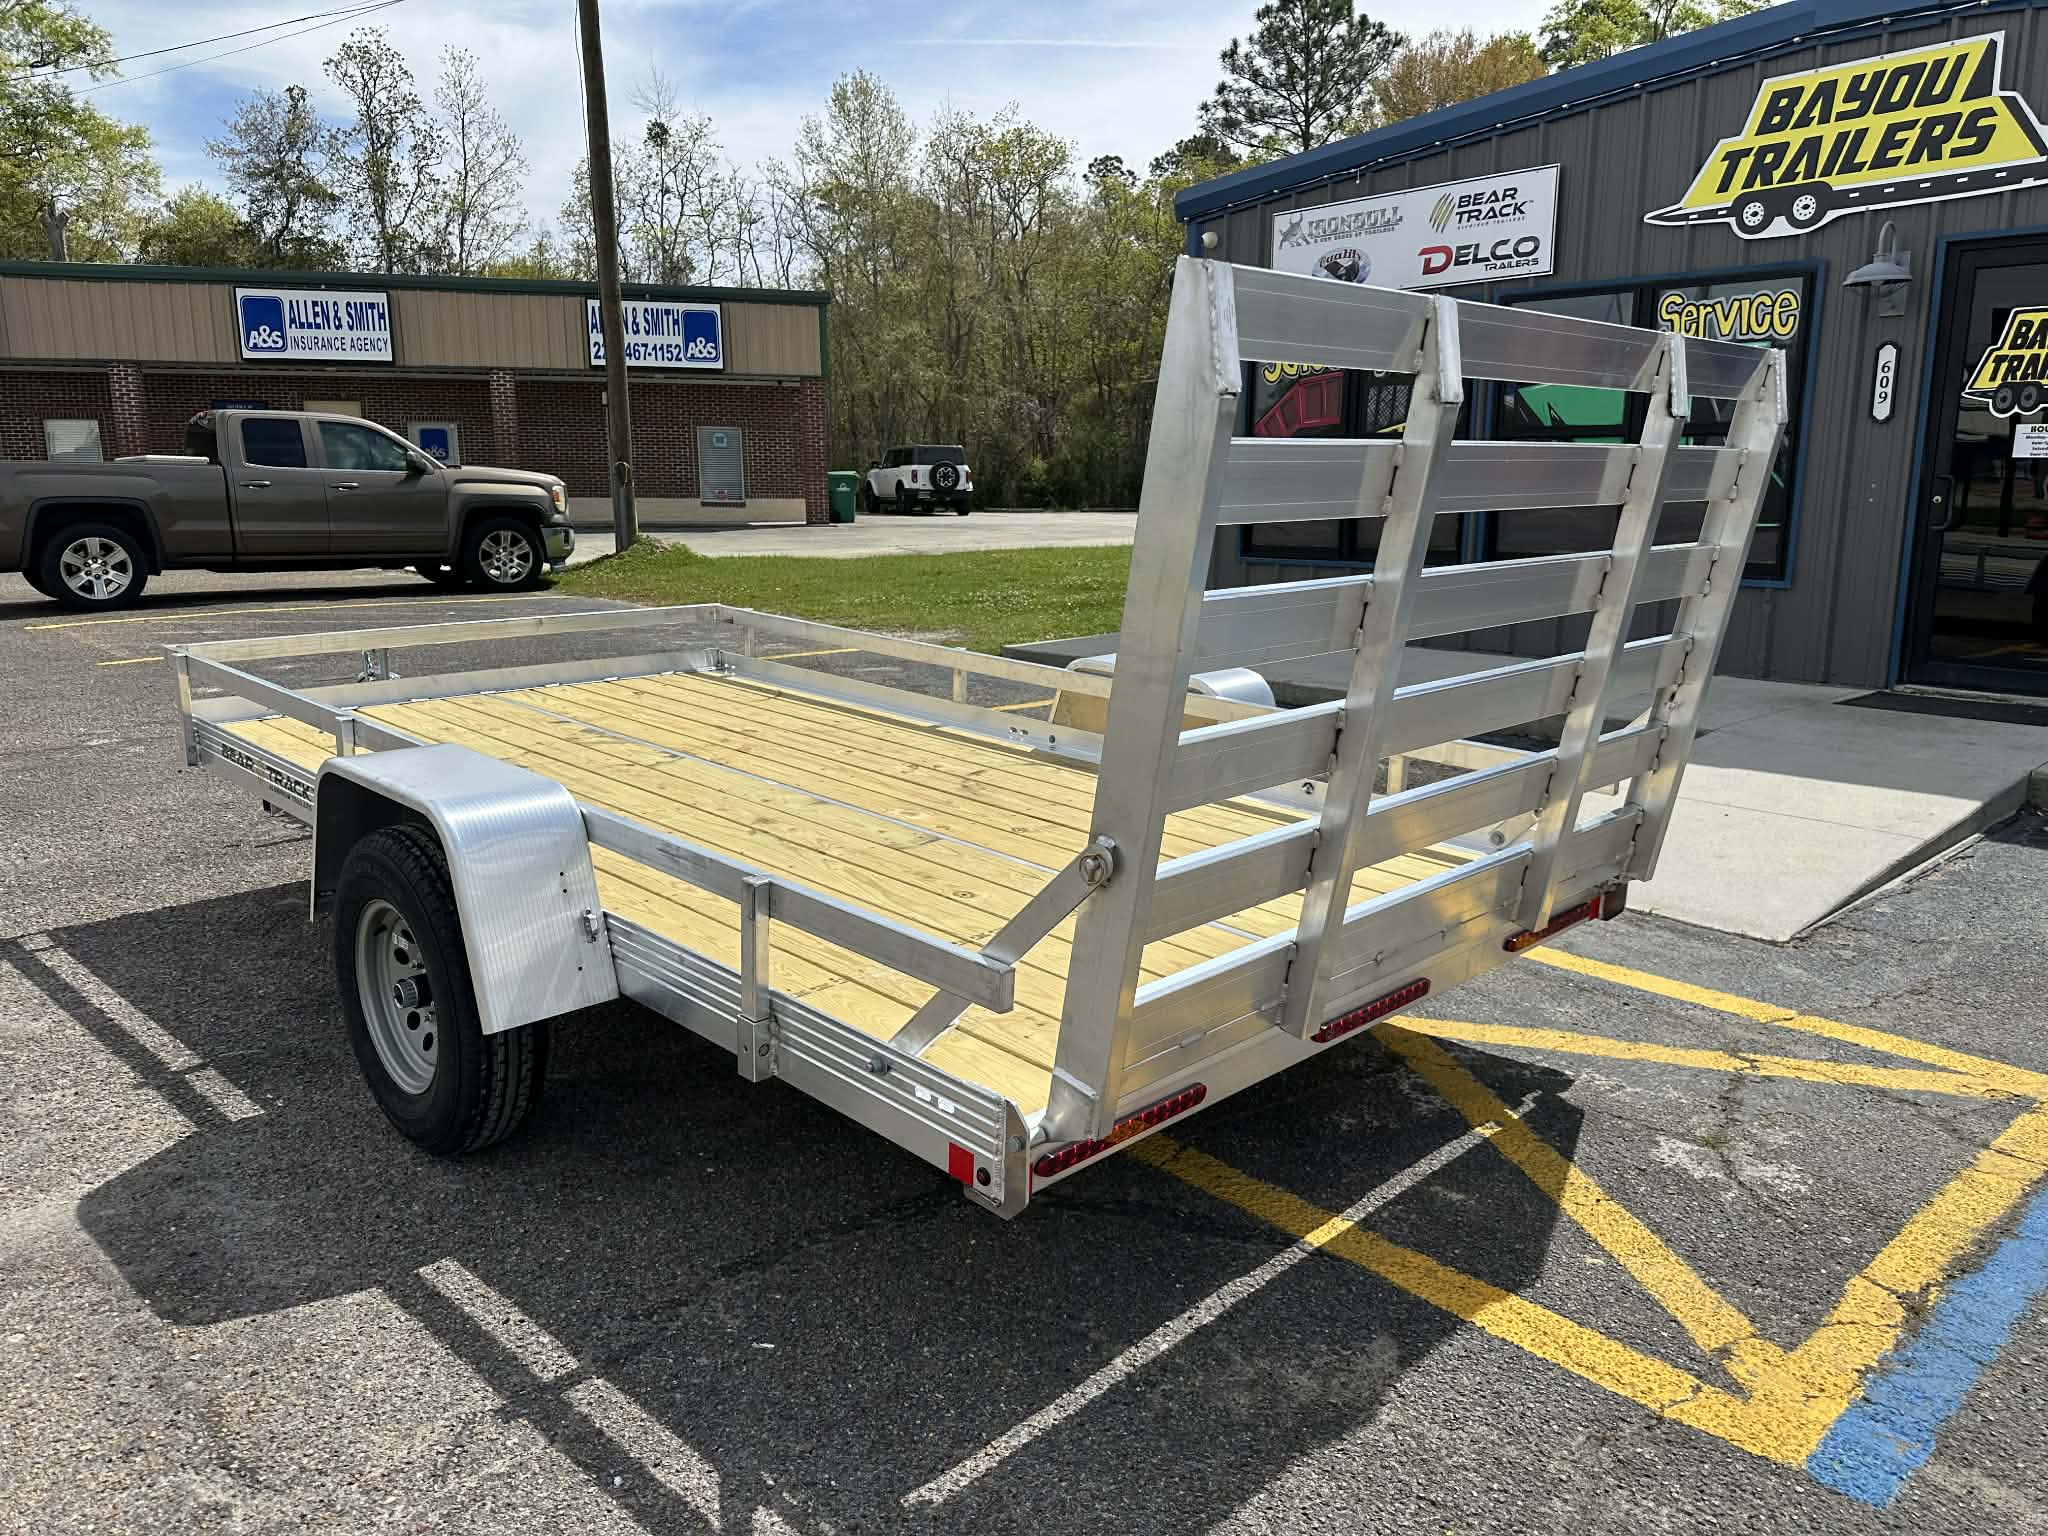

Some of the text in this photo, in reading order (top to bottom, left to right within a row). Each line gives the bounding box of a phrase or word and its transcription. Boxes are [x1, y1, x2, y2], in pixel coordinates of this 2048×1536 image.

[1754, 52, 1969, 136] BAYOU
[1716, 106, 1997, 193] TRAILERS
[1456, 201, 1528, 224] TRACK
[1457, 187, 1518, 209] BEAR
[1417, 235, 1541, 276] DELCO
[1484, 258, 1540, 271] TRAILERS
[288, 300, 388, 332] ALLEN & SMITH
[631, 307, 641, 335] &
[643, 309, 681, 337] SMITH
[249, 325, 283, 348] A&S
[290, 336, 389, 352] INSURANCE AGENCY
[687, 337, 717, 358] A&S
[1877, 360, 1892, 404] 609
[221, 743, 255, 772] BEAR
[264, 764, 315, 802] TRACK
